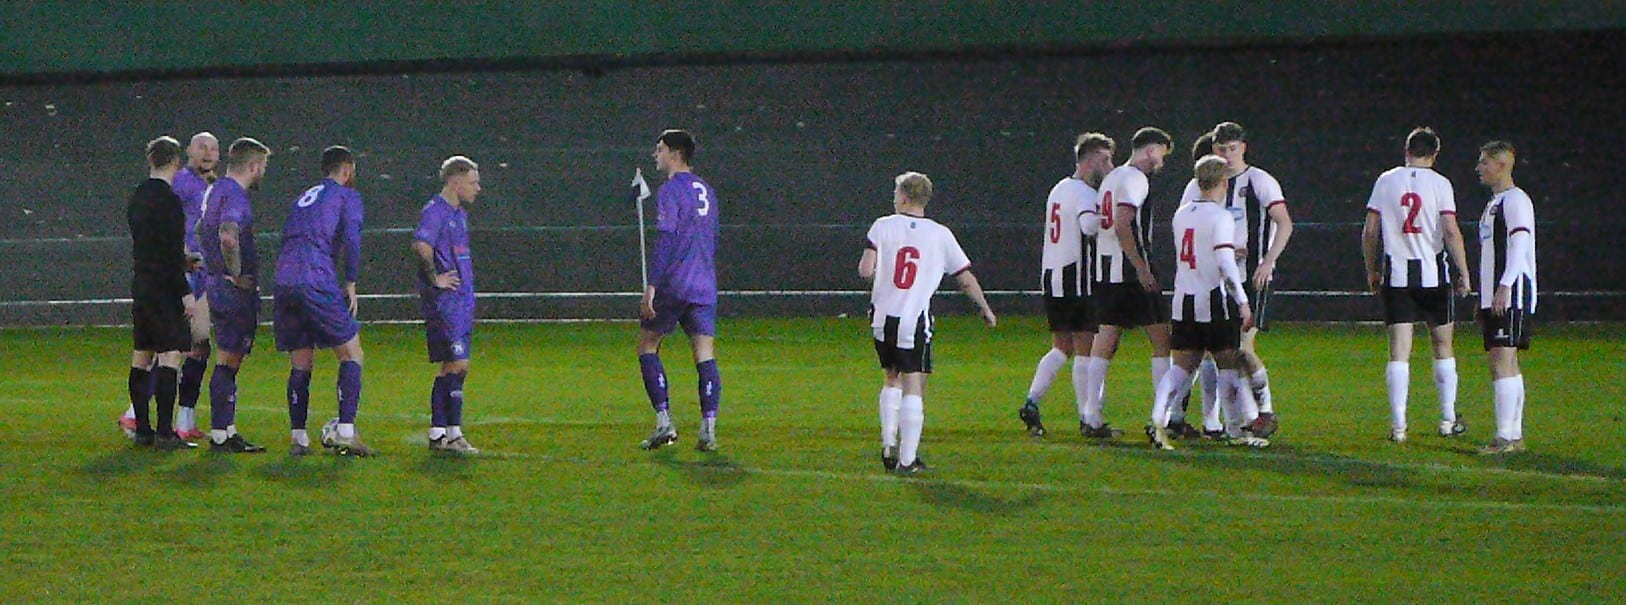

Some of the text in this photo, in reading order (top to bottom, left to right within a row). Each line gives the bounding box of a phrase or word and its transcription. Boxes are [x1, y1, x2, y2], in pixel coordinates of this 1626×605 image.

[297, 184, 325, 208] 8
[692, 181, 710, 216] 3
[1101, 190, 1114, 230] 9
[1400, 192, 1423, 234] 2
[1049, 203, 1061, 244] 5
[893, 246, 921, 290] 6
[1180, 228, 1197, 270] 4
